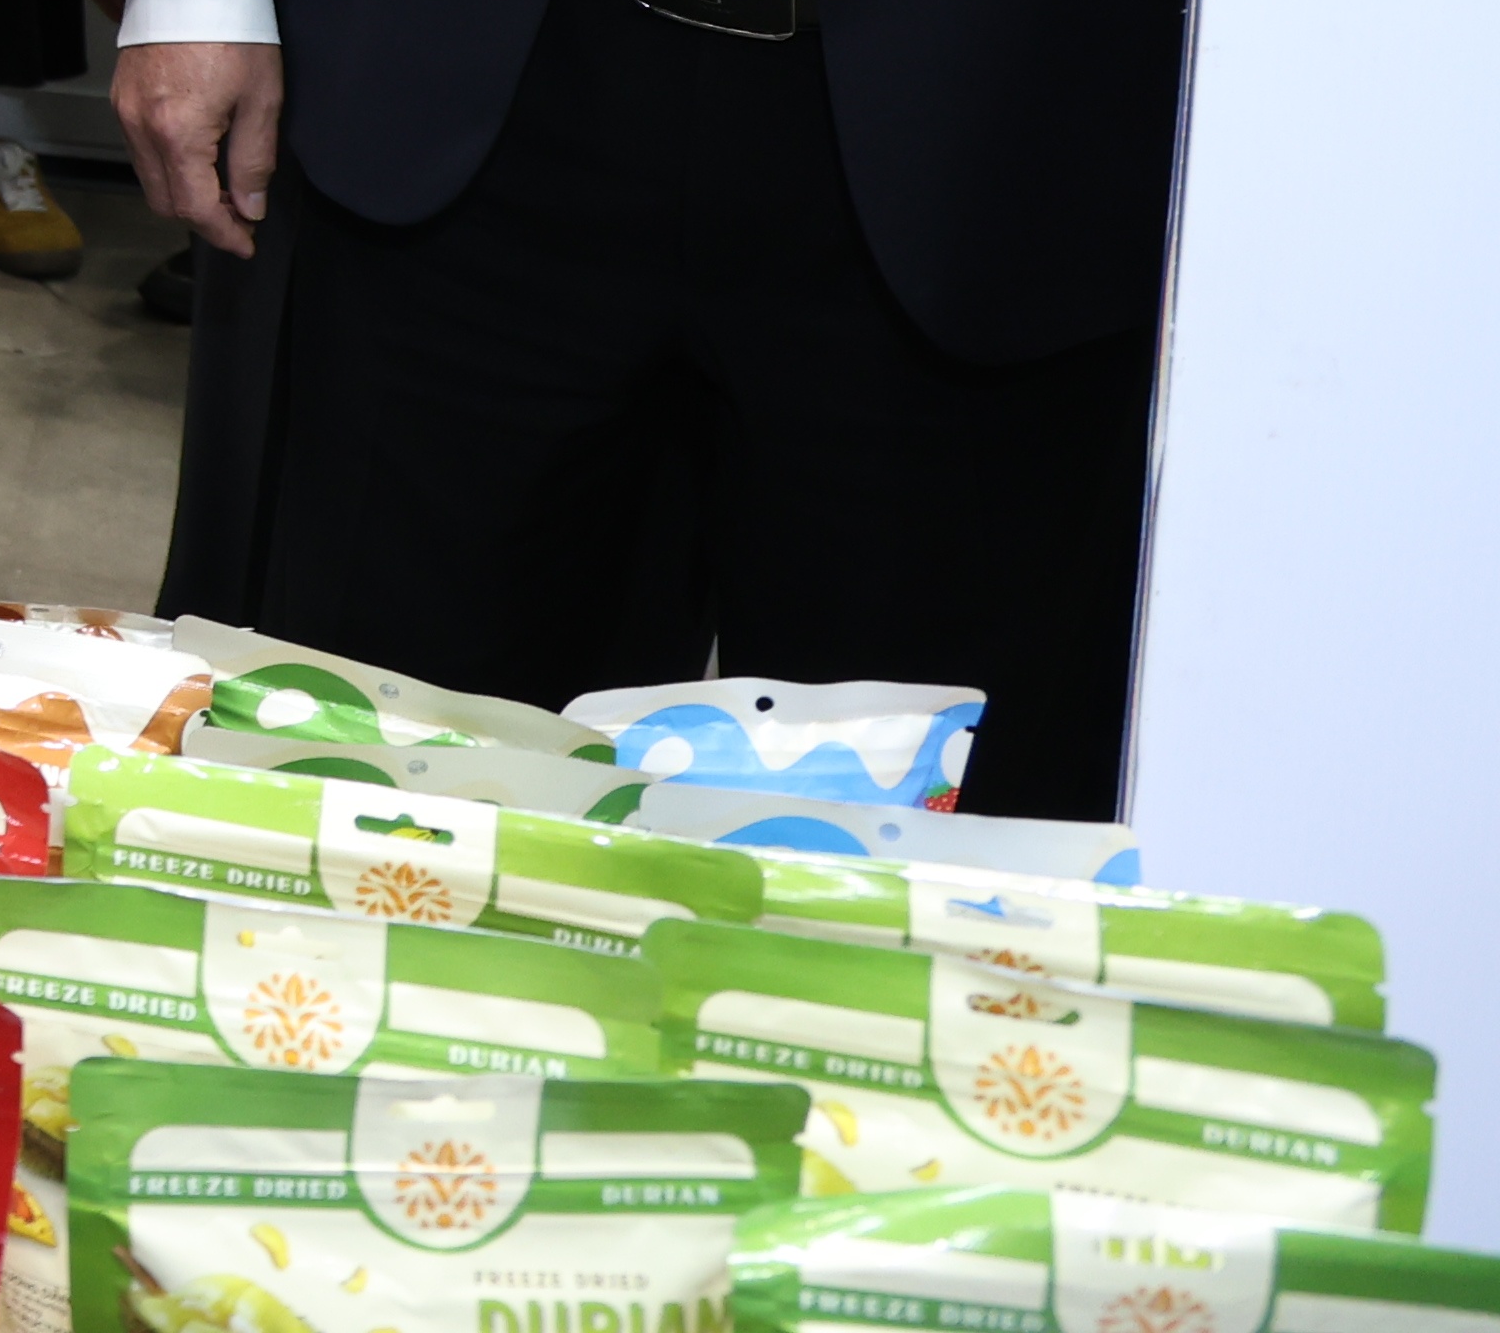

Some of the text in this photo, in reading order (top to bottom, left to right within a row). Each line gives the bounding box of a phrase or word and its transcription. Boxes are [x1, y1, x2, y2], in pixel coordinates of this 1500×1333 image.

[112, 849, 311, 898] FREEZE DRIED
[108, 990, 197, 1023] DRIED
[448, 1044, 568, 1079] DURIAN
[697, 1035, 924, 1090] FREEZE DRIED
[1202, 1123, 1339, 1168] DURIAN
[130, 1173, 348, 1203] FREEZE DRIED
[602, 1184, 720, 1210] DURIAN
[473, 1270, 650, 1292] FREEZE DRIED
[800, 1288, 1048, 1333] FREEZE DRIED
